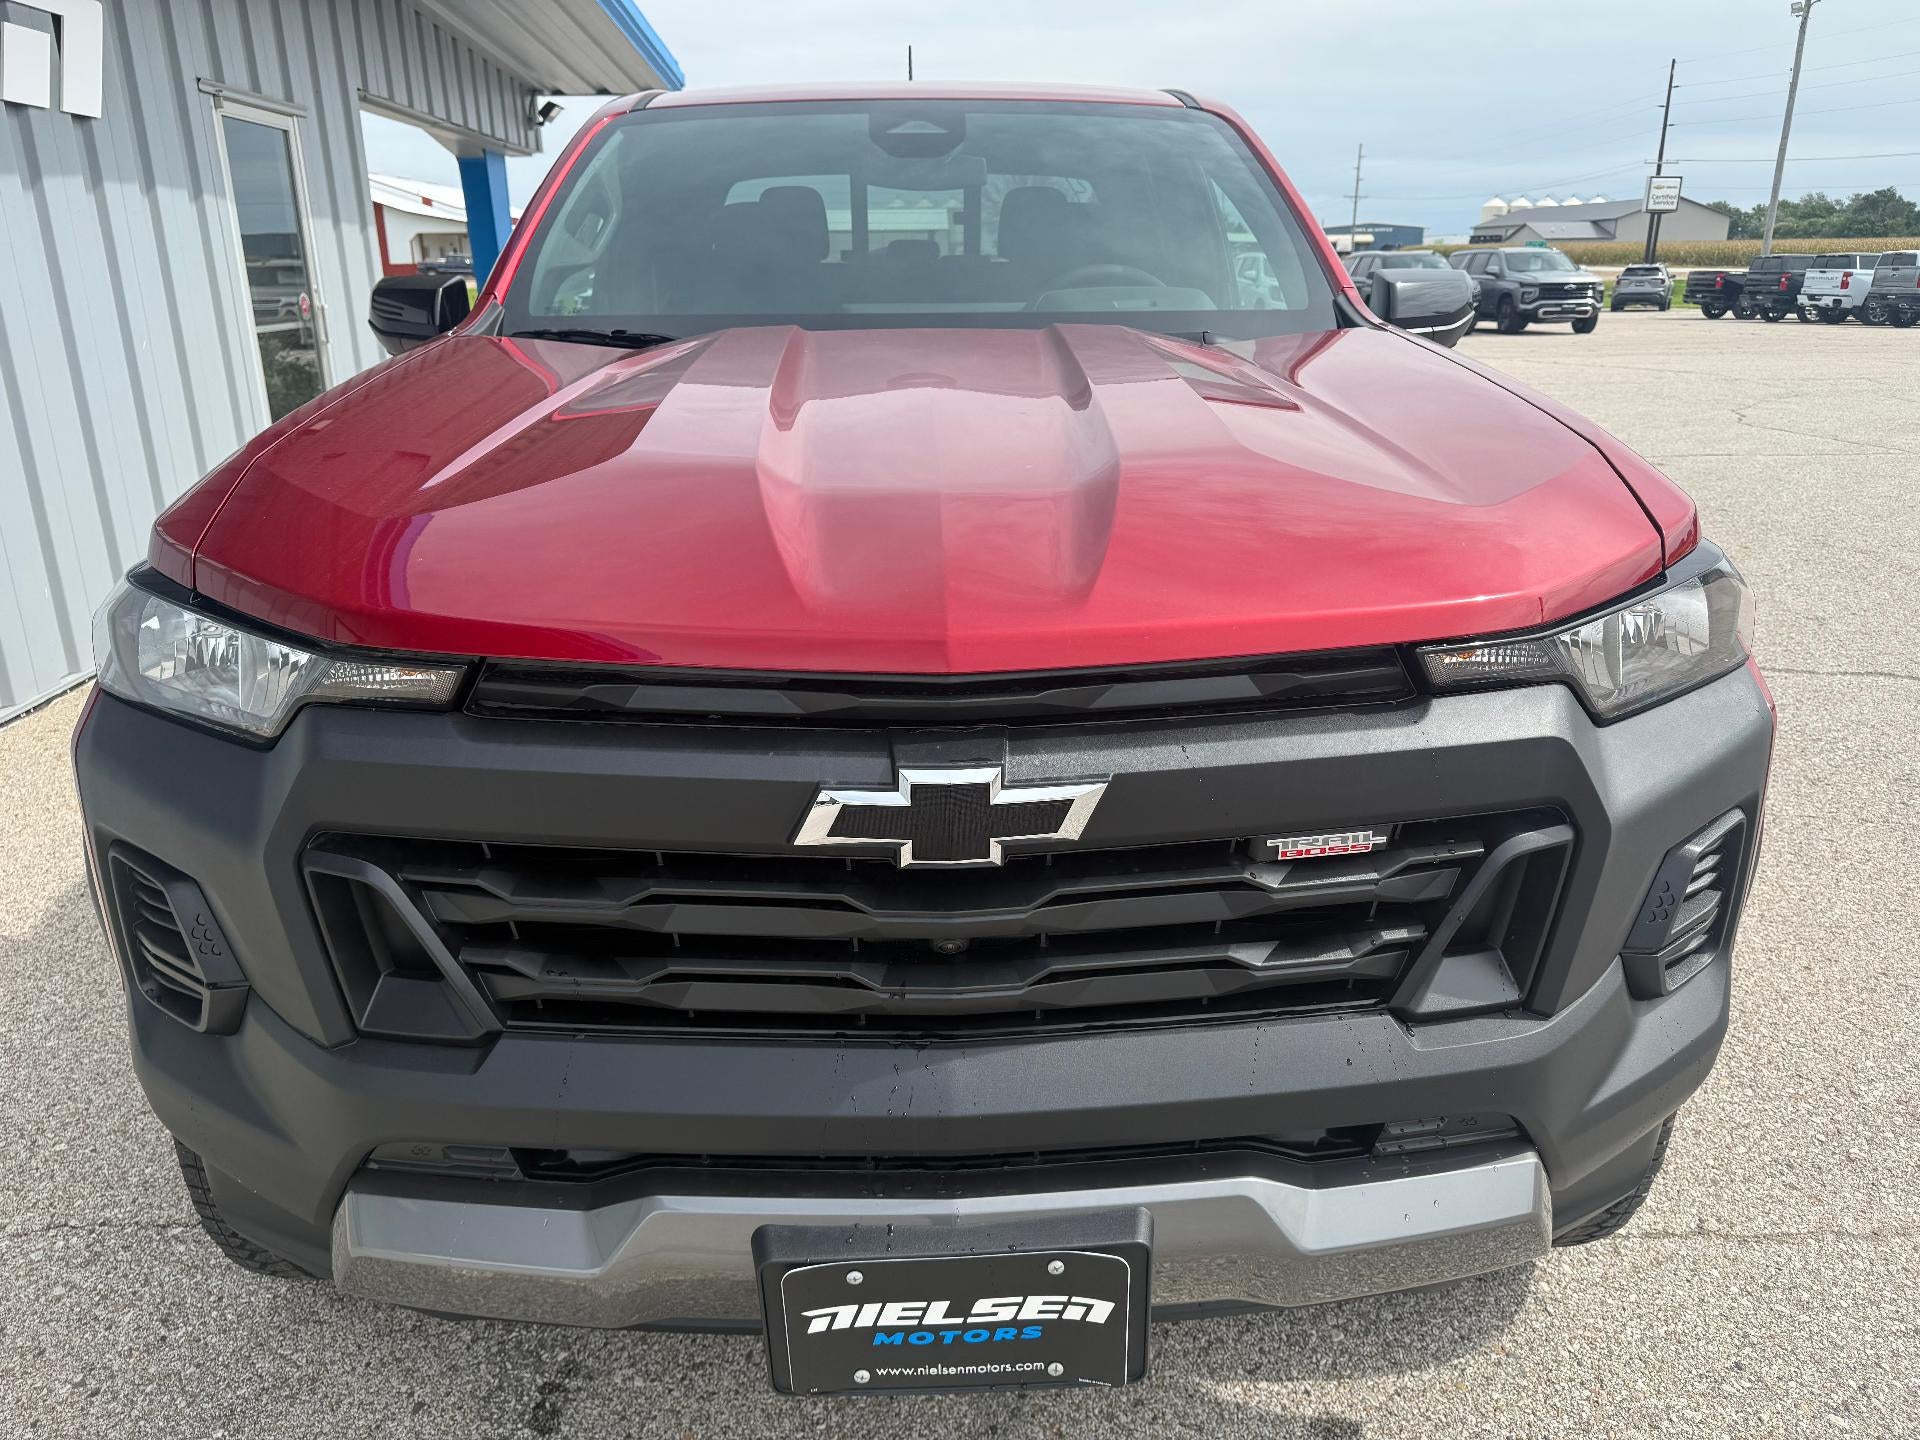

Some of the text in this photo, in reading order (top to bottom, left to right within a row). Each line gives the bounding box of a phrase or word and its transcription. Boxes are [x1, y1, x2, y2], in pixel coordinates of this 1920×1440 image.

[1267, 831, 1387, 849] TRAIL
[1278, 843, 1372, 860] BOSS
[801, 1295, 1116, 1335] NIELSEN
[873, 1325, 1044, 1346] MOTORS
[876, 1360, 1045, 1377] www.nielsenmotors.com
